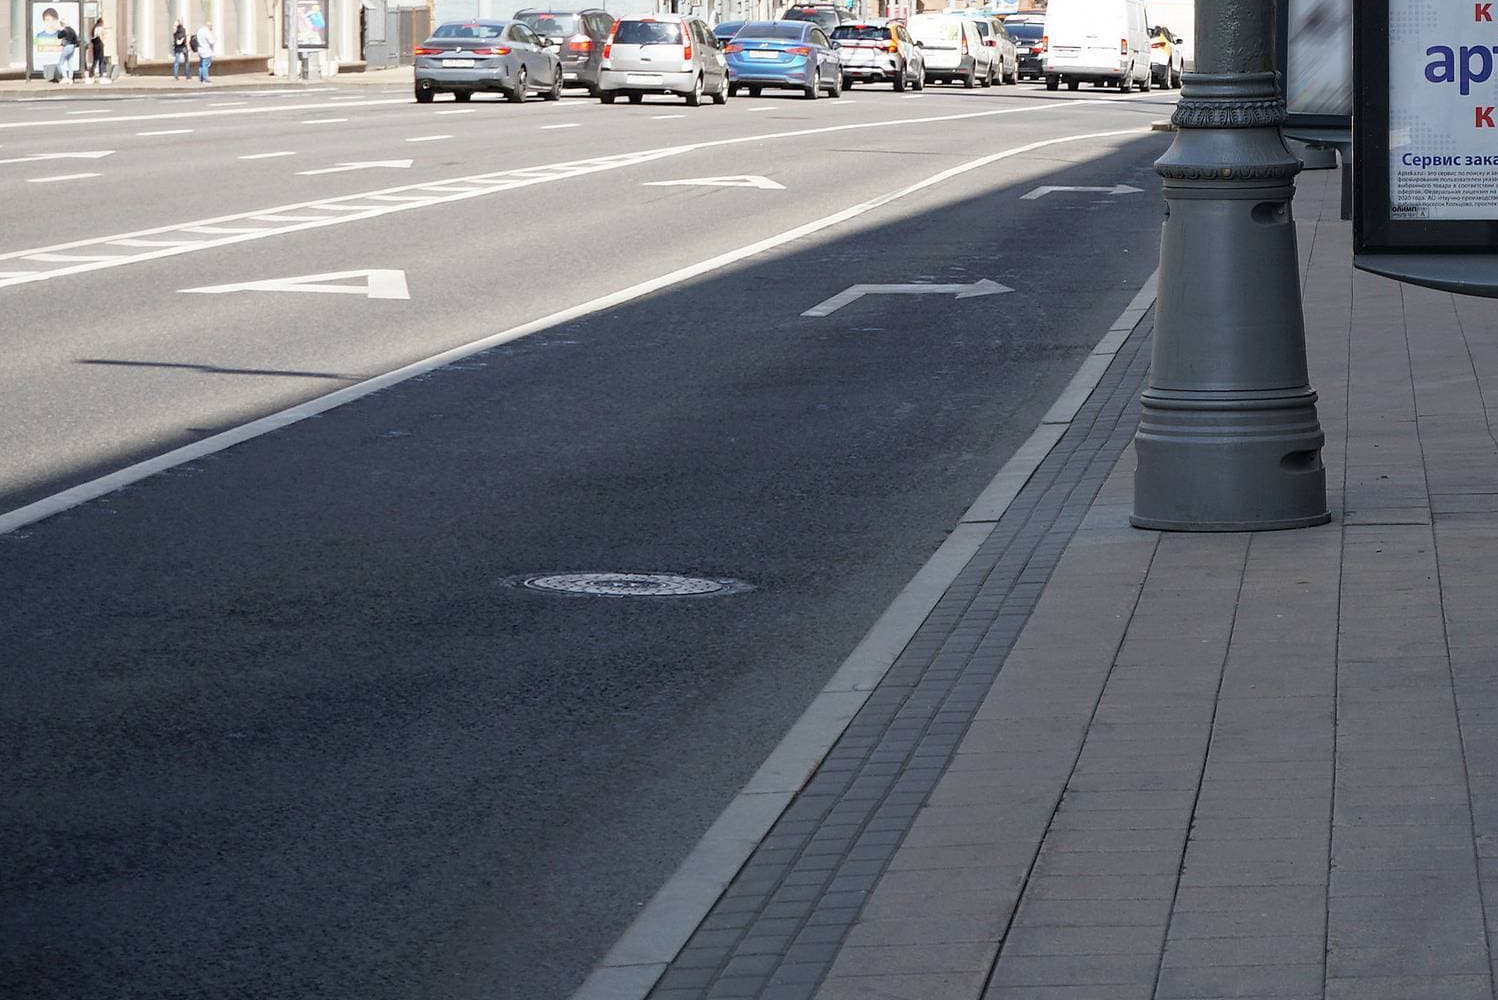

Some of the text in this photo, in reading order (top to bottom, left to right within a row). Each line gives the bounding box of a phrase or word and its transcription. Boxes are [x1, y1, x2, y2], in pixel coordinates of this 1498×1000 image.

[1475, 3, 1493, 22] к
[1475, 106, 1495, 128] к
[1401, 153, 1461, 170] Сервис
